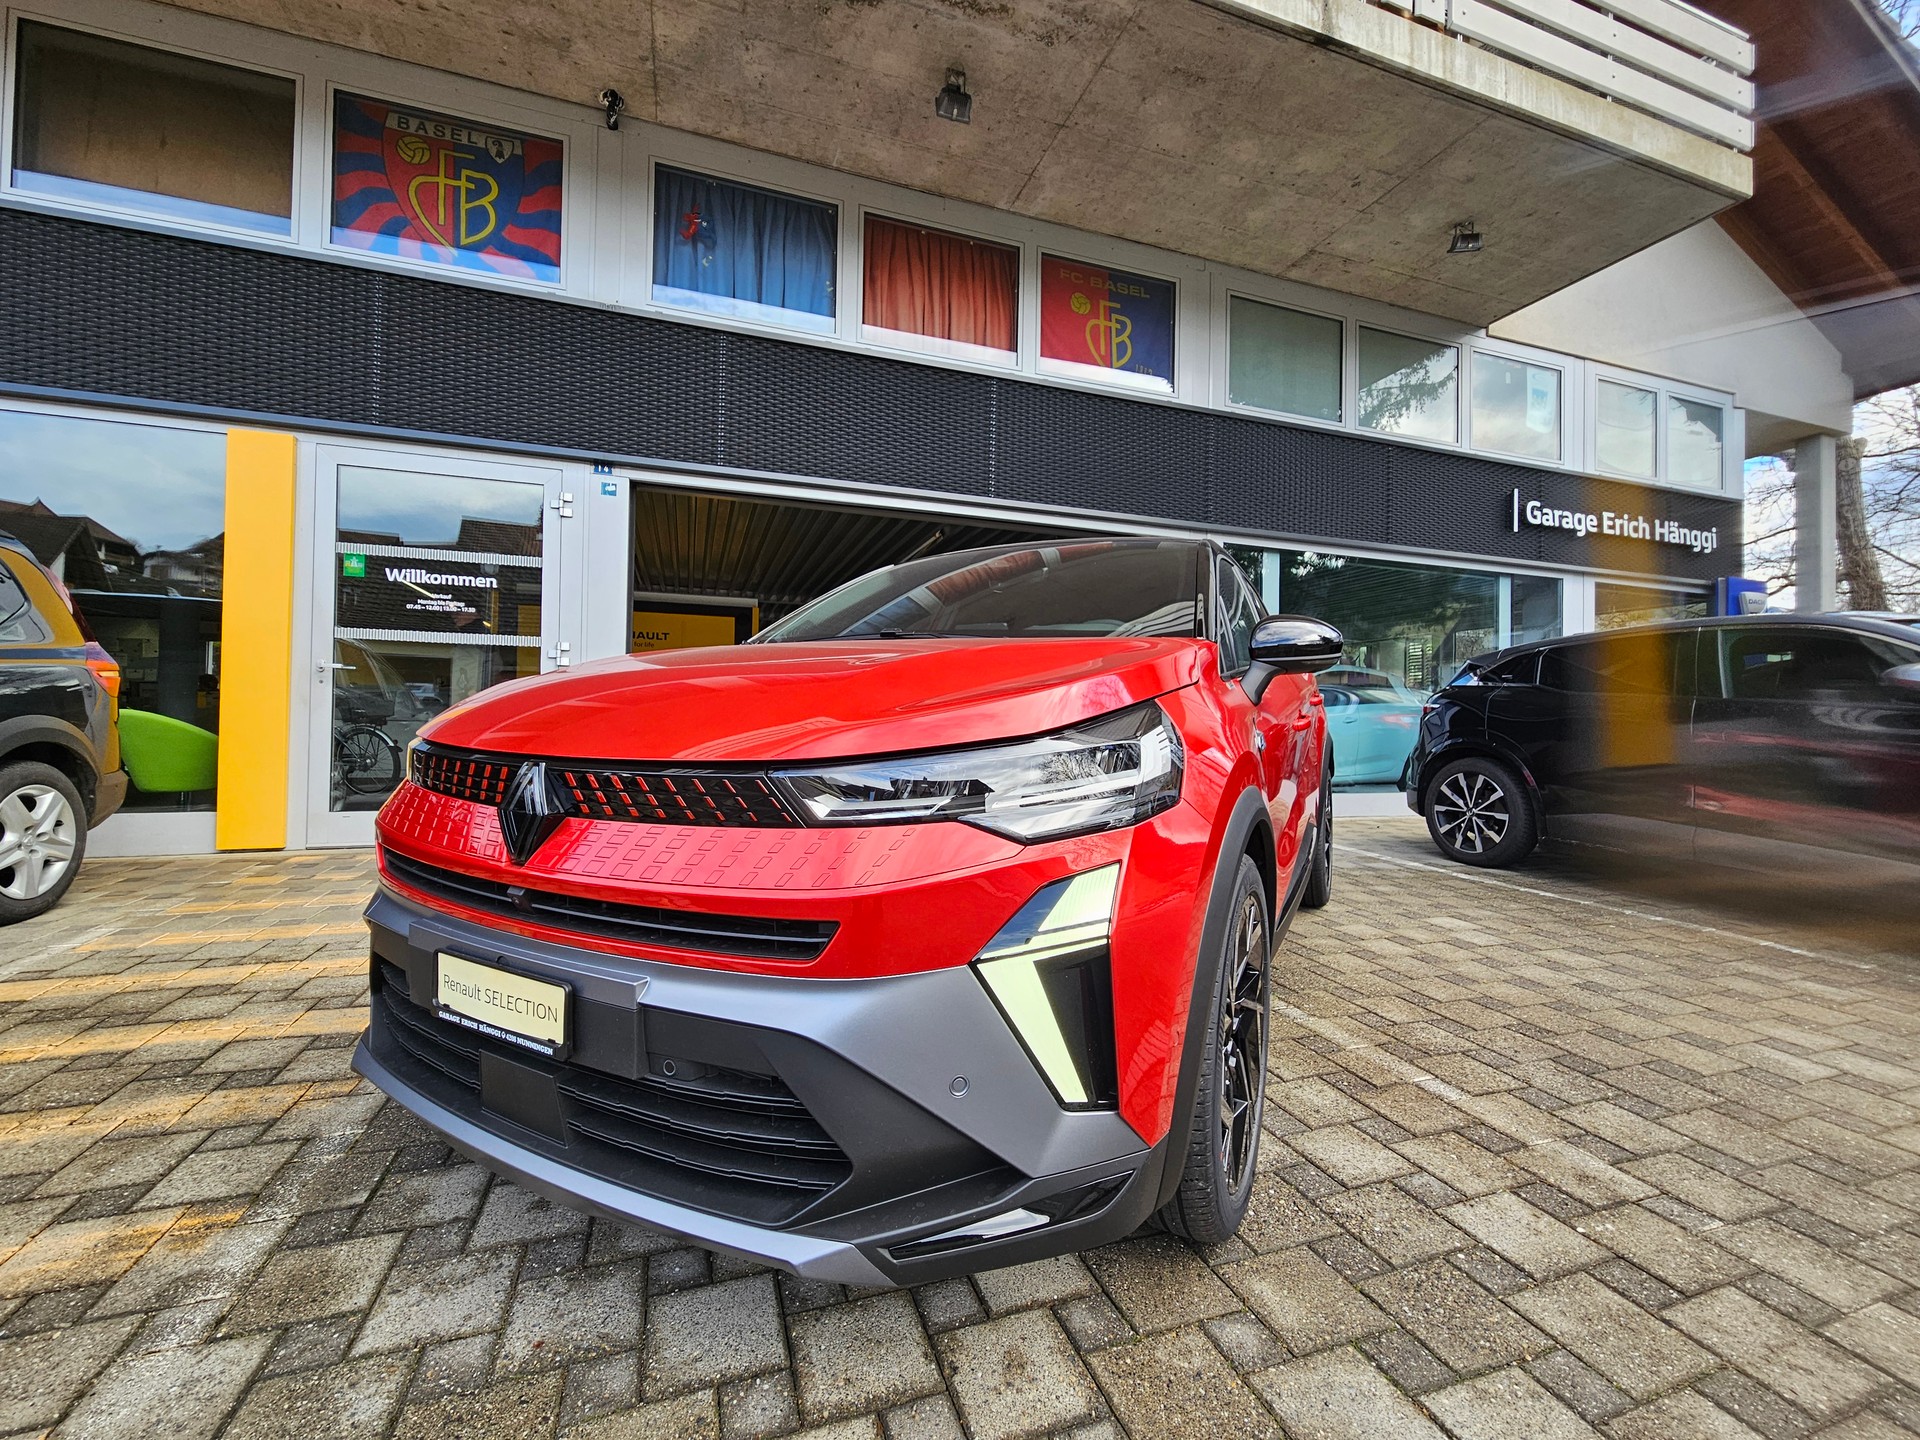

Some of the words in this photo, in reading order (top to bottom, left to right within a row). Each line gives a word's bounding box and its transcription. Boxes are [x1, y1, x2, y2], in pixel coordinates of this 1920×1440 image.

[397, 115, 478, 145] BASEL
[1060, 268, 1084, 284] FC
[1090, 276, 1151, 298] BASEL
[1526, 501, 1598, 537] Garage
[1602, 512, 1650, 540] Erich
[1655, 519, 1717, 554] Hänggi
[385, 567, 498, 588] Willkommen
[644, 641, 655, 649] life
[443, 974, 481, 1001] Renault
[484, 988, 558, 1023] SELECTION
[438, 1011, 460, 1024] GARAGE
[461, 1018, 478, 1029] ERICH
[479, 1024, 500, 1038] HÄNGGI
